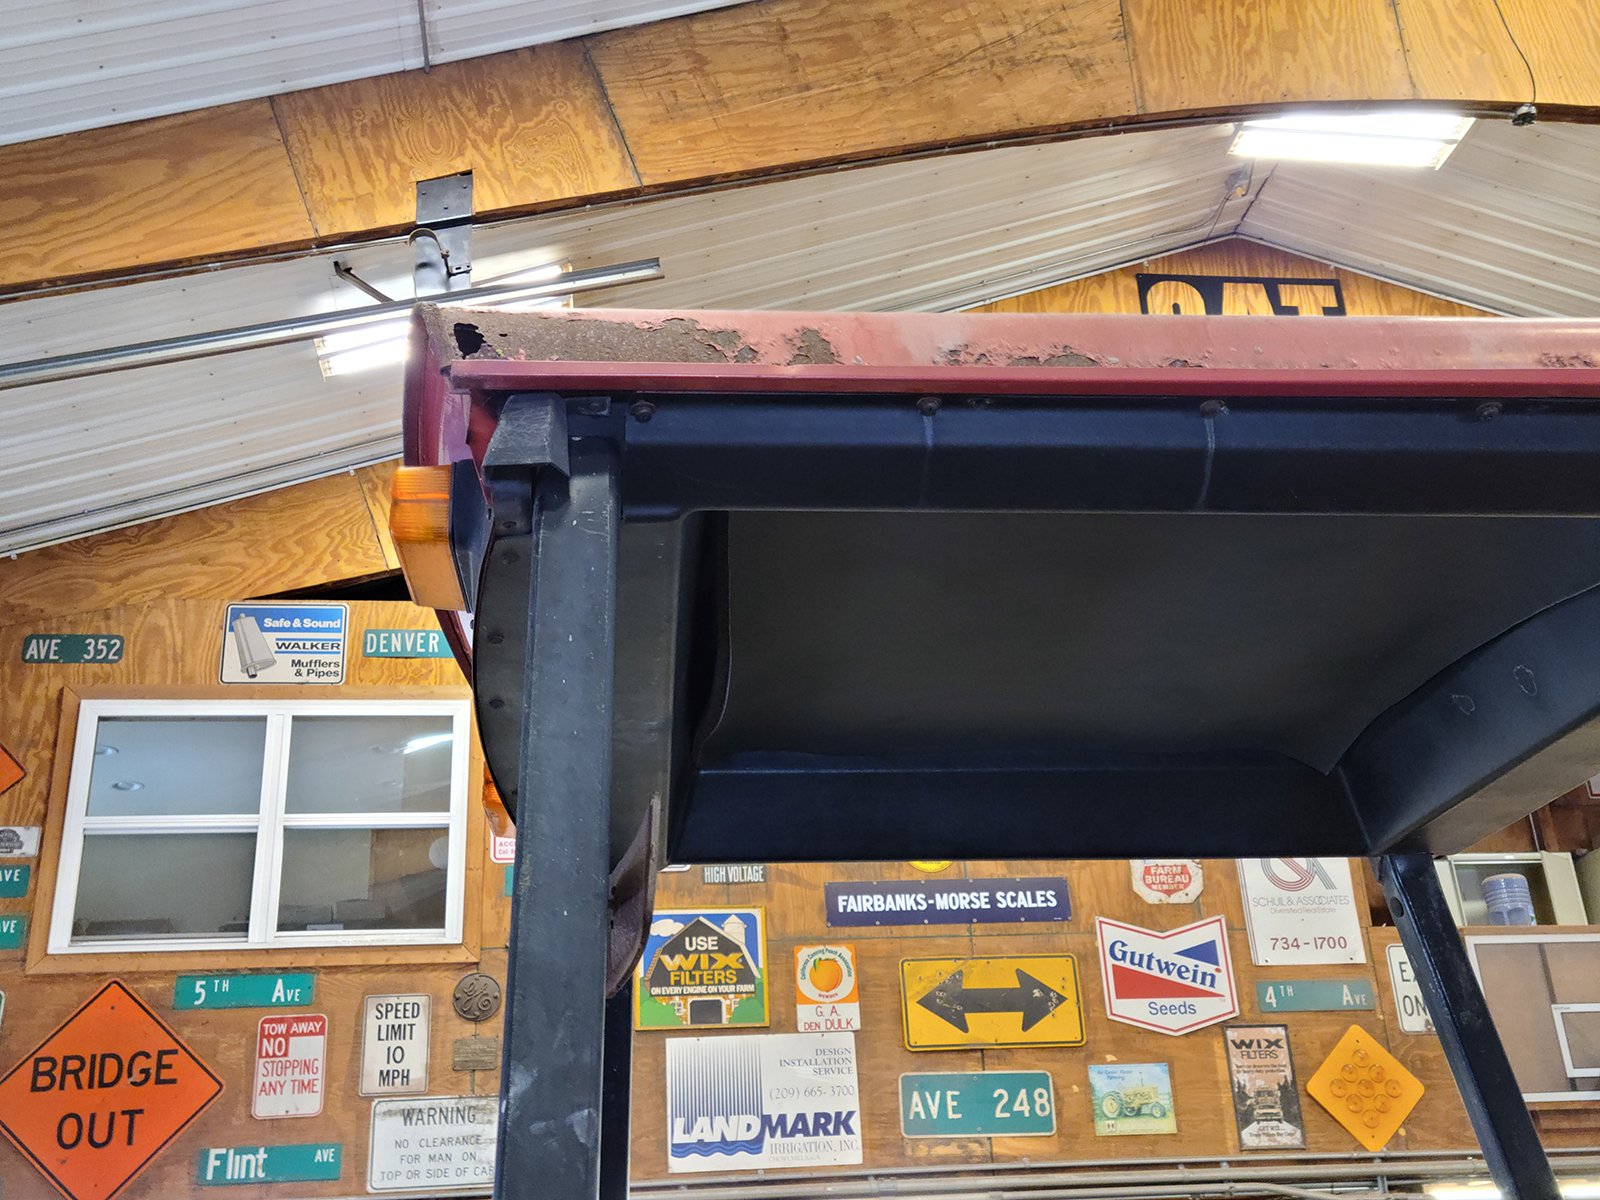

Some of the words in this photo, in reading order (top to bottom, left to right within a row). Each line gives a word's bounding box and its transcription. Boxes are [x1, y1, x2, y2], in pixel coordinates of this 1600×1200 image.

[263, 617, 291, 629] Safe
[292, 618, 302, 628] &
[303, 618, 341, 629] Sound
[25, 638, 61, 660] AVE
[83, 638, 121, 660] 352
[275, 641, 341, 651] WALKER
[366, 632, 440, 653] DENVER
[291, 659, 341, 669] Mufflers
[294, 669, 304, 678] &
[306, 668, 340, 679] Pipes
[704, 866, 727, 883] HIGH
[728, 866, 764, 882] VOLTAGE
[1150, 866, 1182, 874] FARM
[1145, 874, 1189, 884] BUREAU
[838, 891, 991, 913] FAIRBANKS-MORSE
[996, 890, 1058, 909] SCALES
[1287, 896, 1295, 906] &
[1297, 895, 1350, 906] ASSOCIATES
[0, 920, 17, 933] VE
[685, 936, 718, 951] USE
[1270, 936, 1348, 951] 734-1700
[660, 953, 744, 971] WIX
[1109, 940, 1216, 989] Gutwein
[670, 970, 737, 985] FILTERS
[1399, 961, 1417, 983] E
[651, 986, 661, 995] ON
[662, 986, 682, 995] EVERY
[683, 985, 707, 994] ENGINE
[708, 985, 718, 993] ON
[718, 984, 736, 993] YOUR
[736, 983, 755, 992] FARM
[375, 1002, 420, 1020] SPEED
[1148, 1001, 1197, 1016] Seeds
[263, 1023, 287, 1035] TOW
[290, 1021, 322, 1034] AWAY
[377, 1023, 416, 1041] LIMIT
[803, 1022, 821, 1031] DEN
[825, 1018, 854, 1030] DULK
[262, 1038, 286, 1057] NO
[1231, 1038, 1285, 1050] WIX
[386, 1045, 405, 1064] 10
[815, 1047, 852, 1057] DESIGN
[1240, 1050, 1279, 1060] FILTERS
[262, 1058, 319, 1077] STOPPING
[779, 1057, 852, 1068] INSTALLATION
[30, 1049, 179, 1092] BRIDGE
[378, 1069, 410, 1087] MPH
[812, 1067, 853, 1076] SERVICE
[259, 1080, 287, 1096] ANY
[291, 1078, 319, 1095] TIME
[769, 1087, 800, 1100] (209)
[909, 1090, 962, 1120] AVE
[993, 1088, 1050, 1118] 248
[401, 1105, 476, 1127] WARNING
[56, 1109, 144, 1150] OUT
[673, 1110, 856, 1144] LANDMARK
[395, 1139, 409, 1150] NO
[419, 1134, 482, 1149] CLEARANCE
[206, 1147, 268, 1180] Flint
[315, 1148, 335, 1162] AVE
[400, 1154, 421, 1165] FOR
[428, 1152, 452, 1163] MAN
[462, 1151, 477, 1162] ON
[380, 1171, 402, 1181] TOP
[406, 1169, 420, 1180] OR
[426, 1168, 450, 1179] SIDE
[455, 1166, 470, 1178] OF
